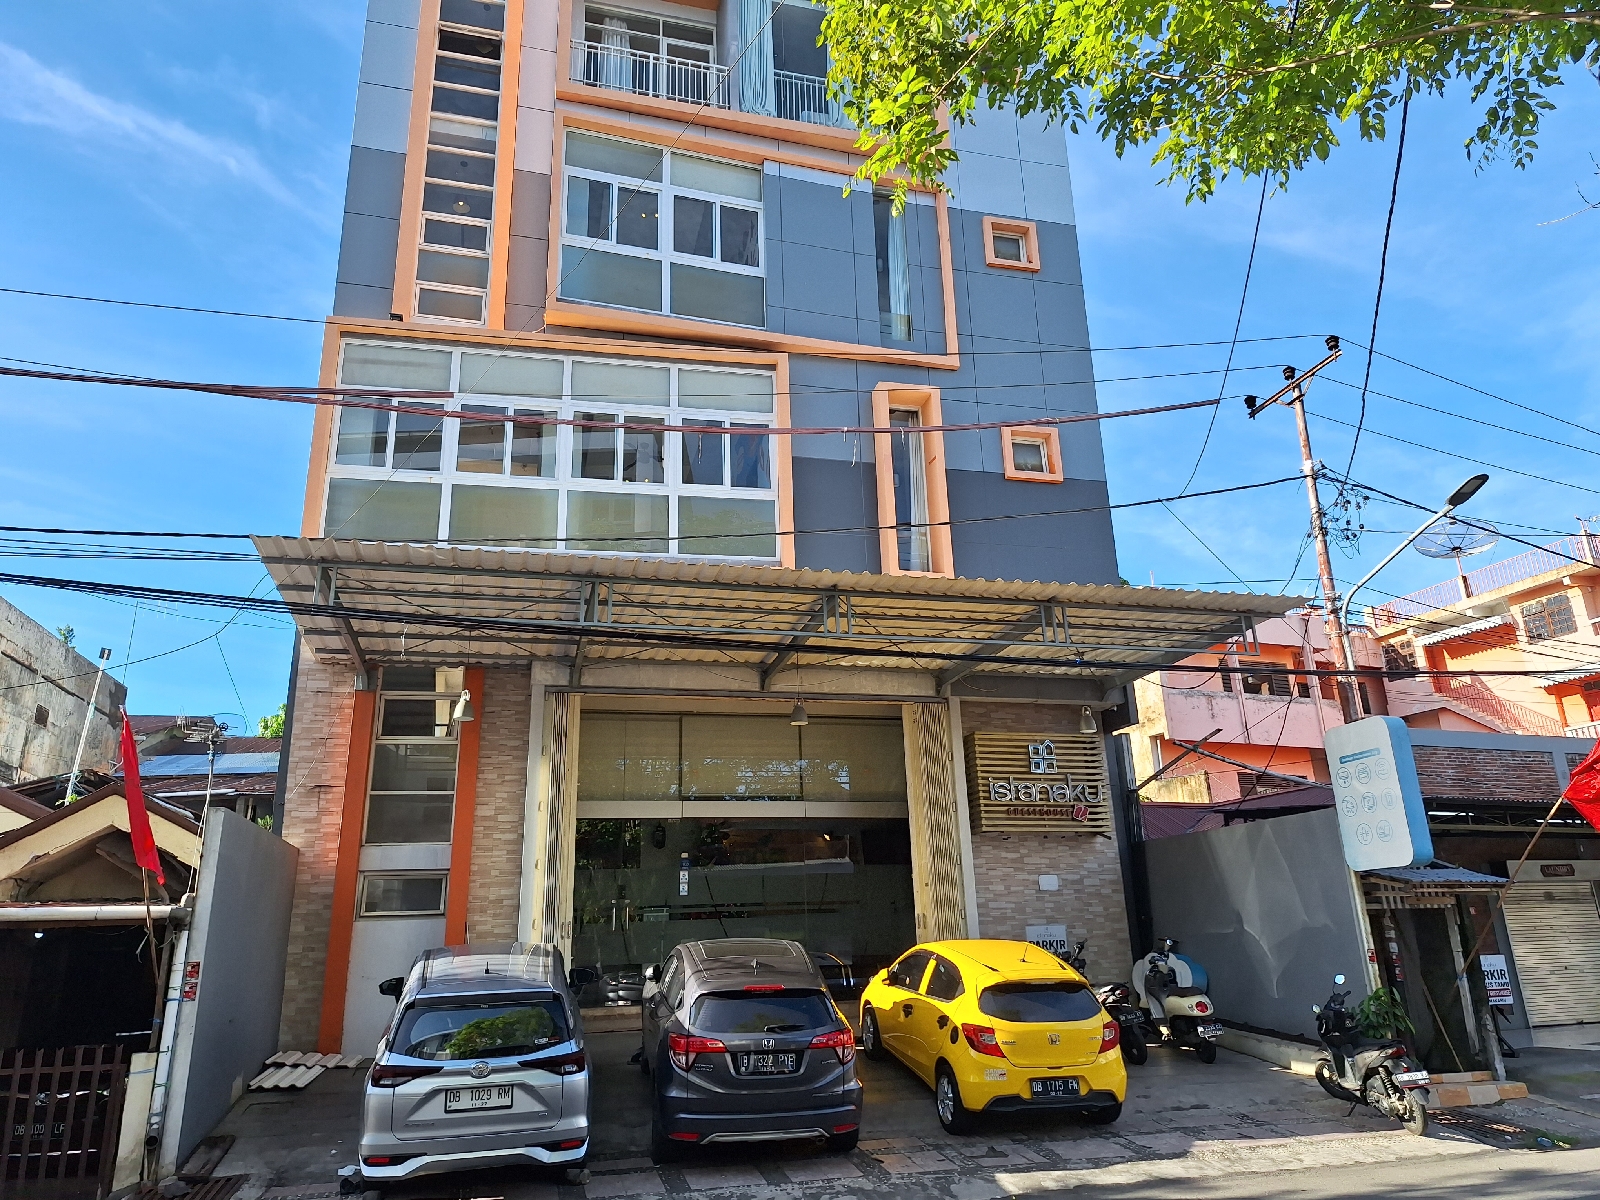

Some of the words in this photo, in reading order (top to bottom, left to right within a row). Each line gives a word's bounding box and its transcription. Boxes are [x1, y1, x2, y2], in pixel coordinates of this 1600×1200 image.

[989, 774, 1103, 803] istanaku
[1484, 969, 1508, 981] RKIR
[1032, 1081, 1043, 1092] DB
[449, 1090, 461, 1103] DB
[470, 1089, 492, 1101] 1029
[497, 1086, 511, 1100] RM
